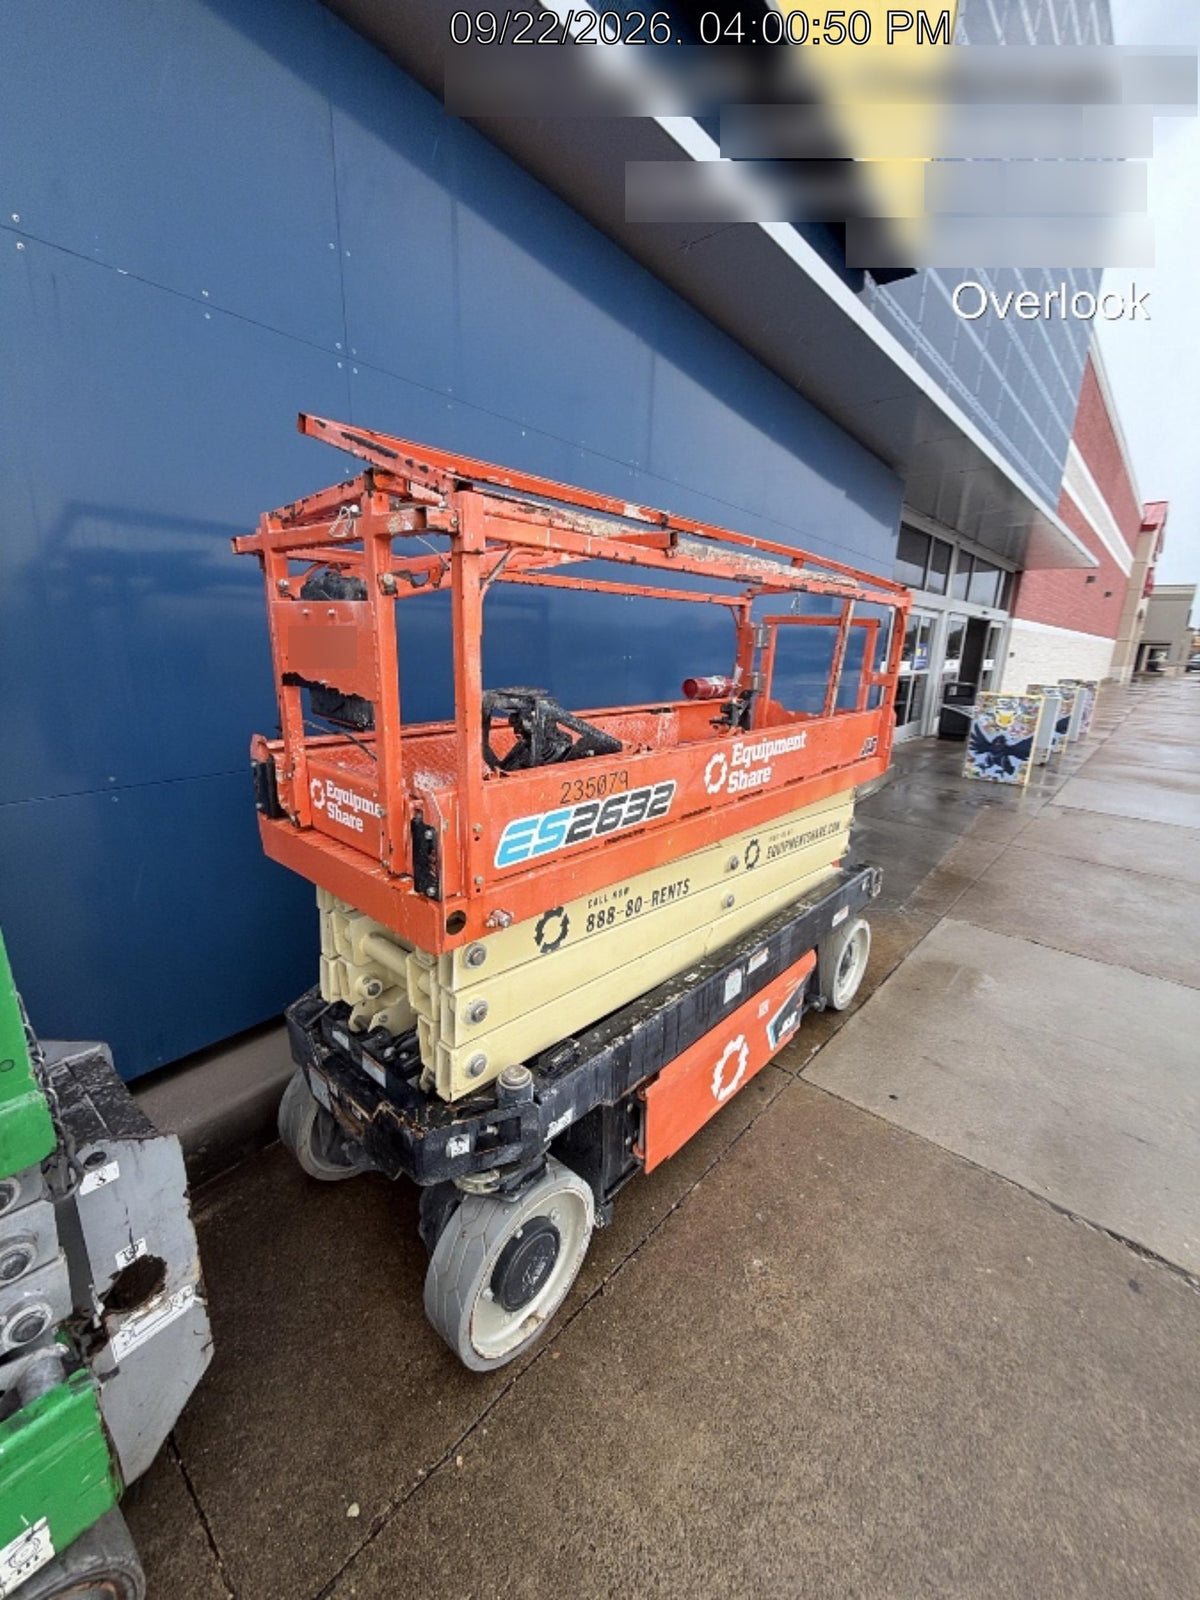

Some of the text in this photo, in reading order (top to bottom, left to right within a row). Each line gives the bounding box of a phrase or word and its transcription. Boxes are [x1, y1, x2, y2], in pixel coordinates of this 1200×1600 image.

[731, 730, 808, 768] Equipment
[326, 779, 386, 818] Equipme
[560, 770, 630, 804] 235079
[727, 767, 773, 794] Share
[326, 801, 364, 832] Share
[497, 781, 676, 867] ES2632
